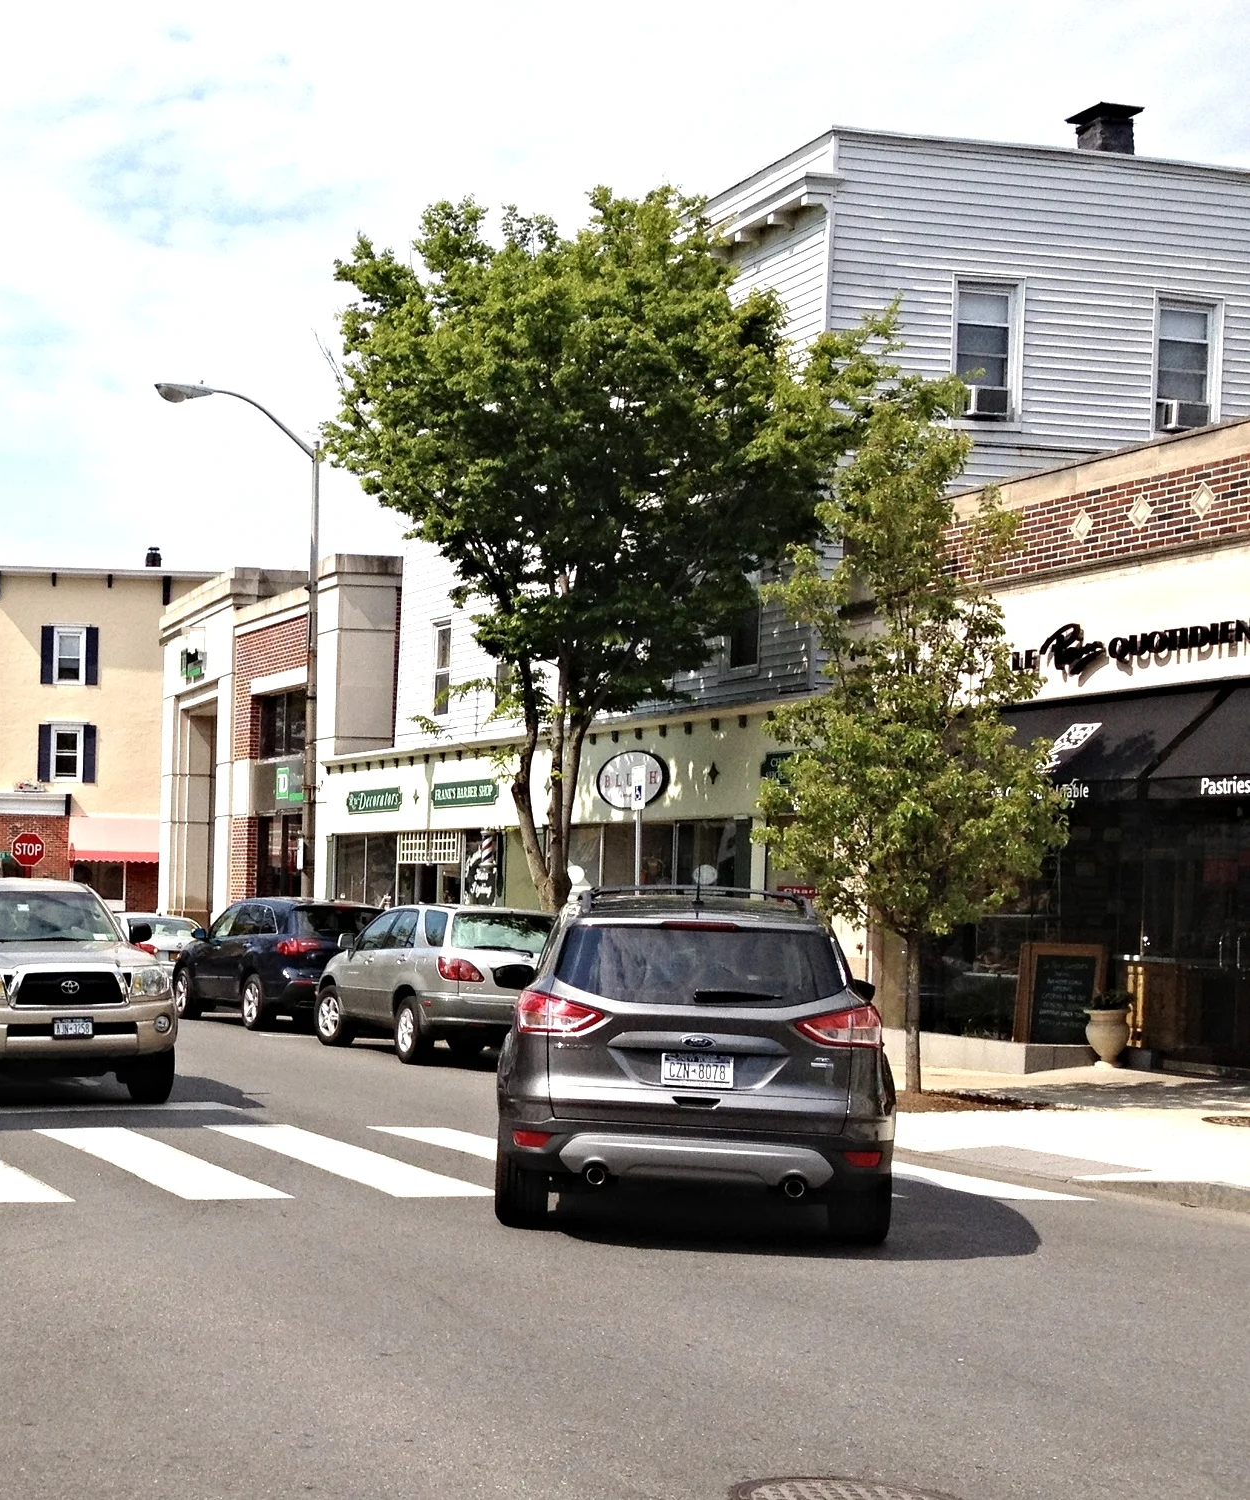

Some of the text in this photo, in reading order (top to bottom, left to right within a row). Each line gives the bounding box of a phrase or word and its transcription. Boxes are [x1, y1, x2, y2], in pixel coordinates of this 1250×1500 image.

[1011, 649, 1039, 671] LE
[604, 770, 658, 788] BLUH
[478, 784, 493, 797] SHOP
[14, 842, 42, 856] STOP
